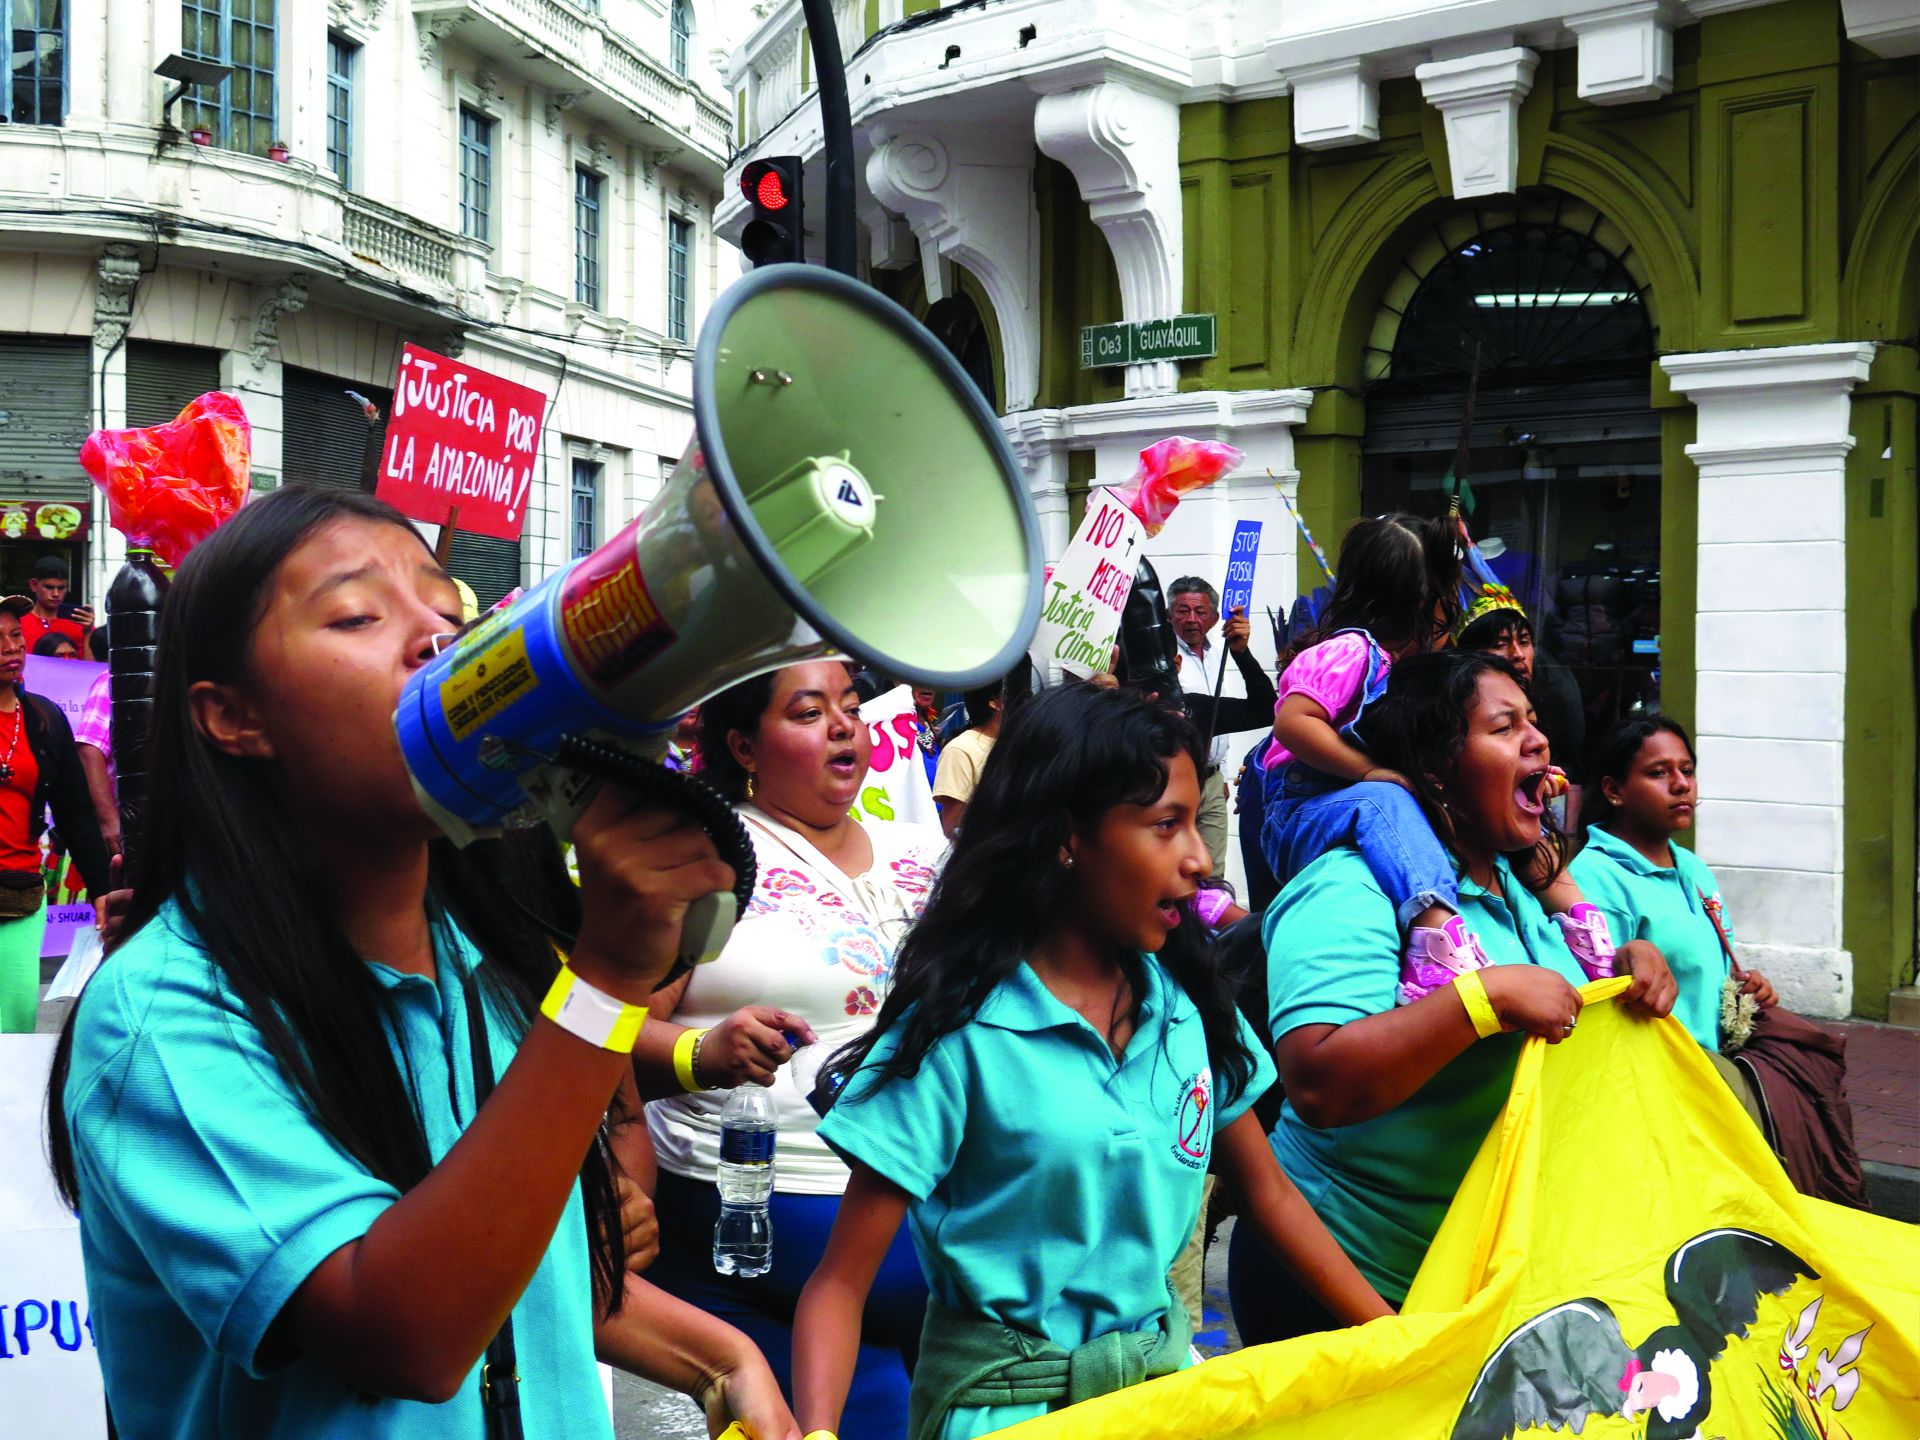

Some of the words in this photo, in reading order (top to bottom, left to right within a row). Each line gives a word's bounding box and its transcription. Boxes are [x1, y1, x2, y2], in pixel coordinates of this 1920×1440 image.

[1099, 334, 1122, 356] Oe3
[1140, 326, 1202, 351] GUAYAQUIL
[505, 407, 536, 453] POR
[386, 434, 415, 483] LA
[423, 442, 530, 522] AMAZONÍA!
[1085, 503, 1125, 549] NO
[1234, 531, 1260, 553] STOP
[1227, 561, 1253, 582] FOSSIL
[58, 911, 90, 923] SHUAR
